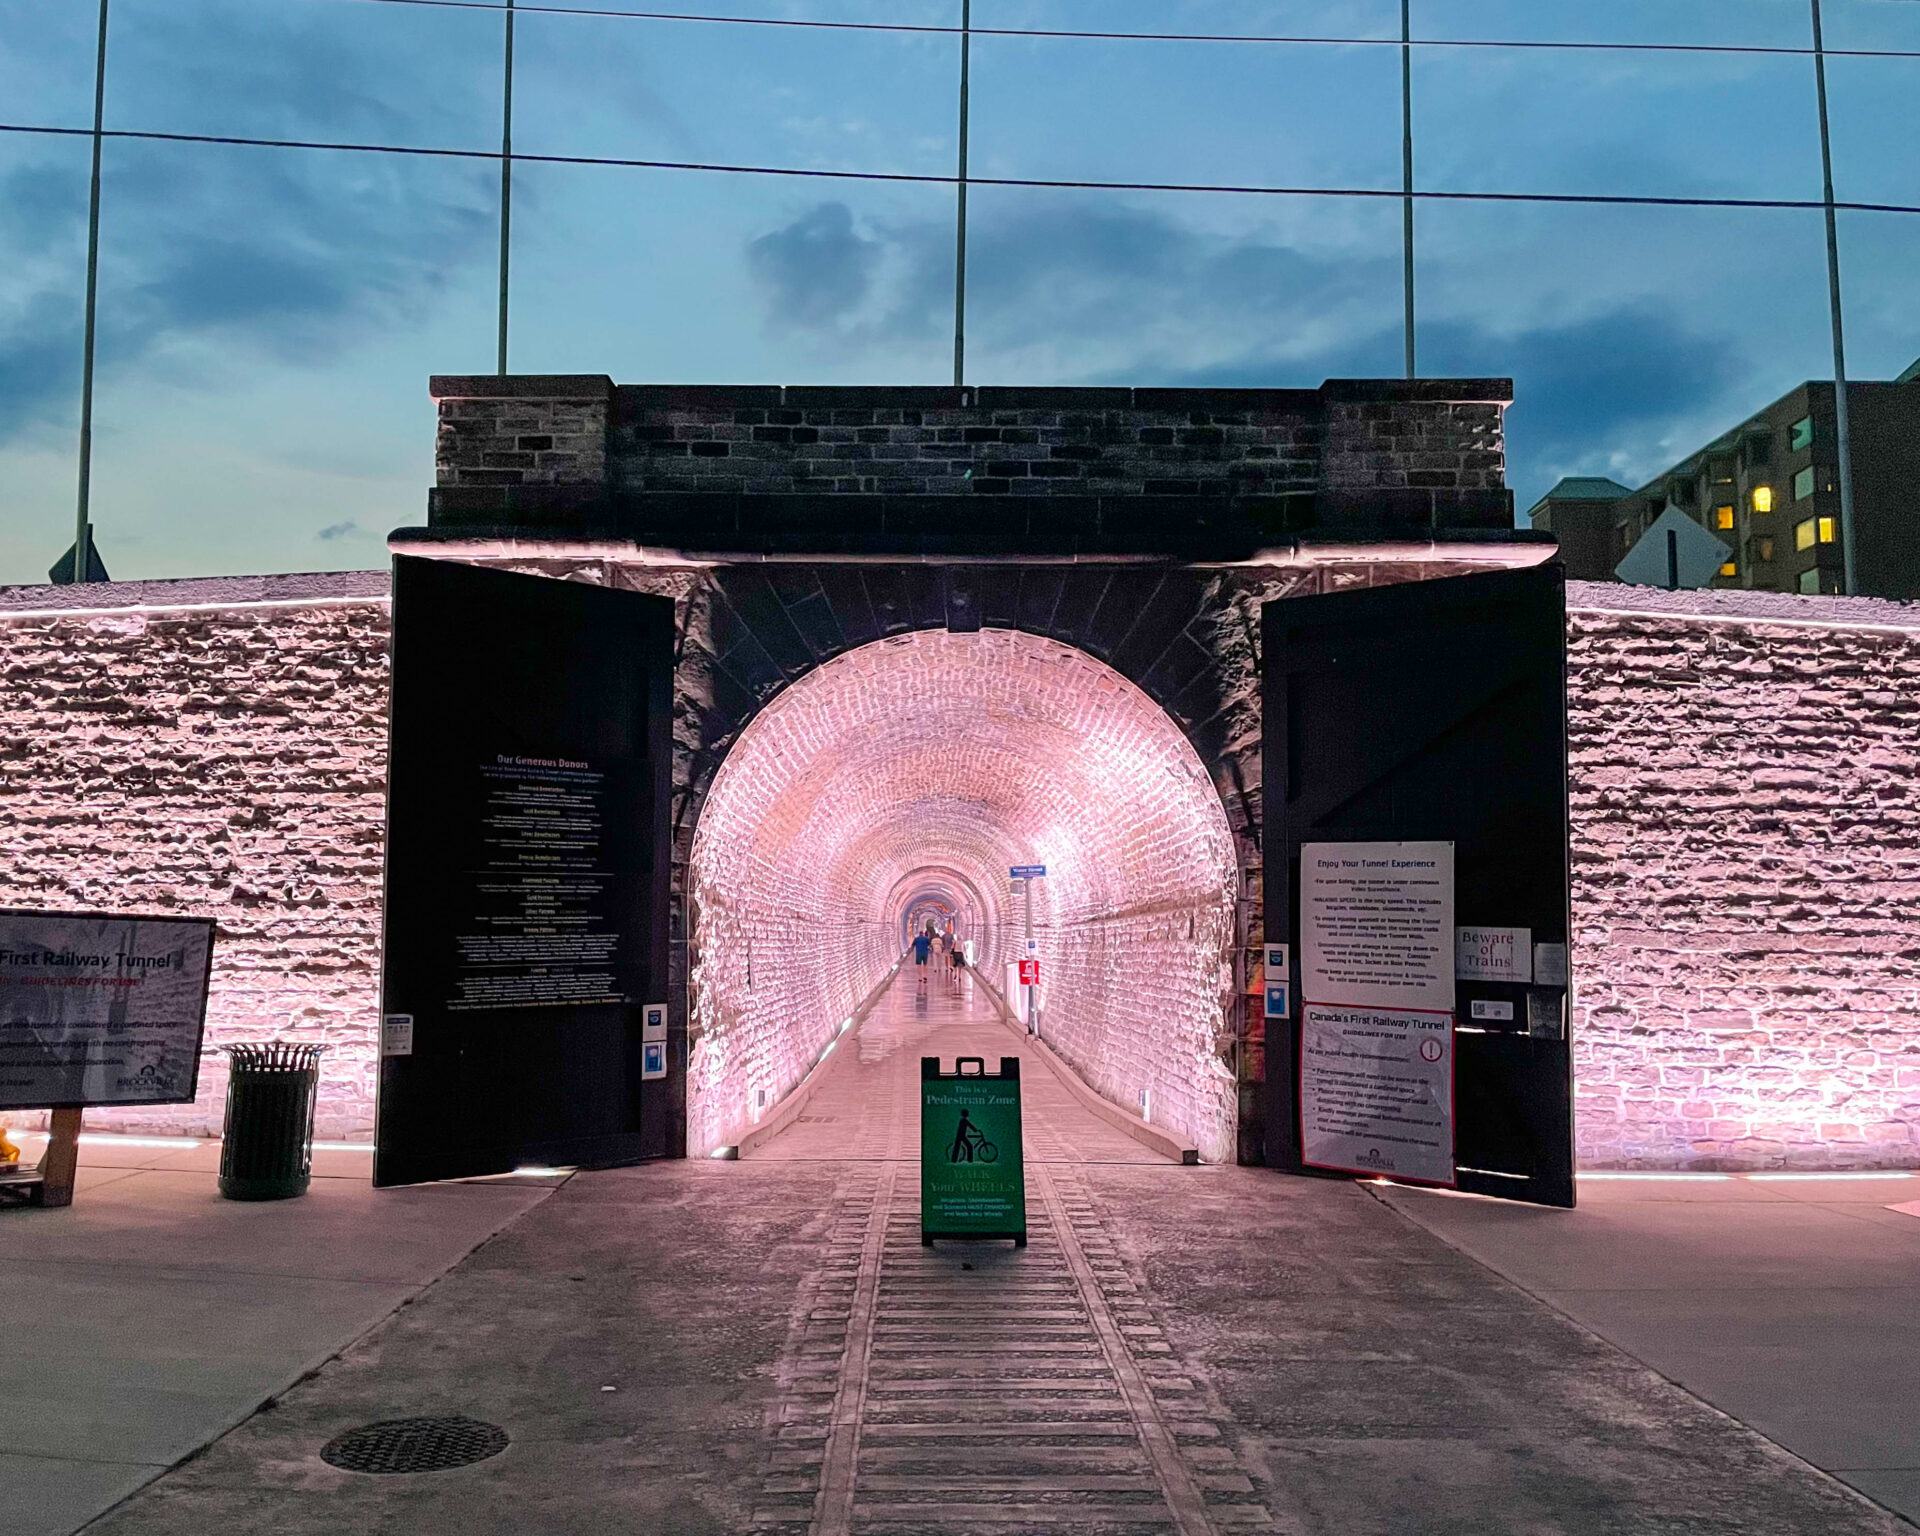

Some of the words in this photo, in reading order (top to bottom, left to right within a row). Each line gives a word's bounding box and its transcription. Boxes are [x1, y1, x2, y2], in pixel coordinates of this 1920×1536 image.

[497, 754, 513, 765] Our
[515, 756, 557, 767] Generous
[558, 758, 589, 769] Donors
[1317, 859, 1339, 869] Enjoy
[1341, 859, 1359, 868] Your
[1361, 859, 1388, 868] Tunnel
[1391, 859, 1435, 870] Experience
[1462, 931, 1514, 945] Beware
[1480, 944, 1493, 955] of
[0, 949, 37, 962] First
[44, 951, 110, 969] Railway
[116, 953, 171, 968] Tunnel
[1465, 954, 1511, 968] Trains
[94, 976, 116, 987] FOR
[1309, 1011, 1349, 1023] Canada's
[1350, 1015, 1370, 1025] First
[1373, 1017, 1409, 1030] Railway
[1412, 1019, 1445, 1031] Tunnel
[1342, 1029, 1379, 1038] GUIDELINES
[926, 1094, 986, 1105] Pedestrian
[987, 1095, 1017, 1105] Zone
[931, 1181, 955, 1193] Your
[959, 1181, 1016, 1193] WHEELS
